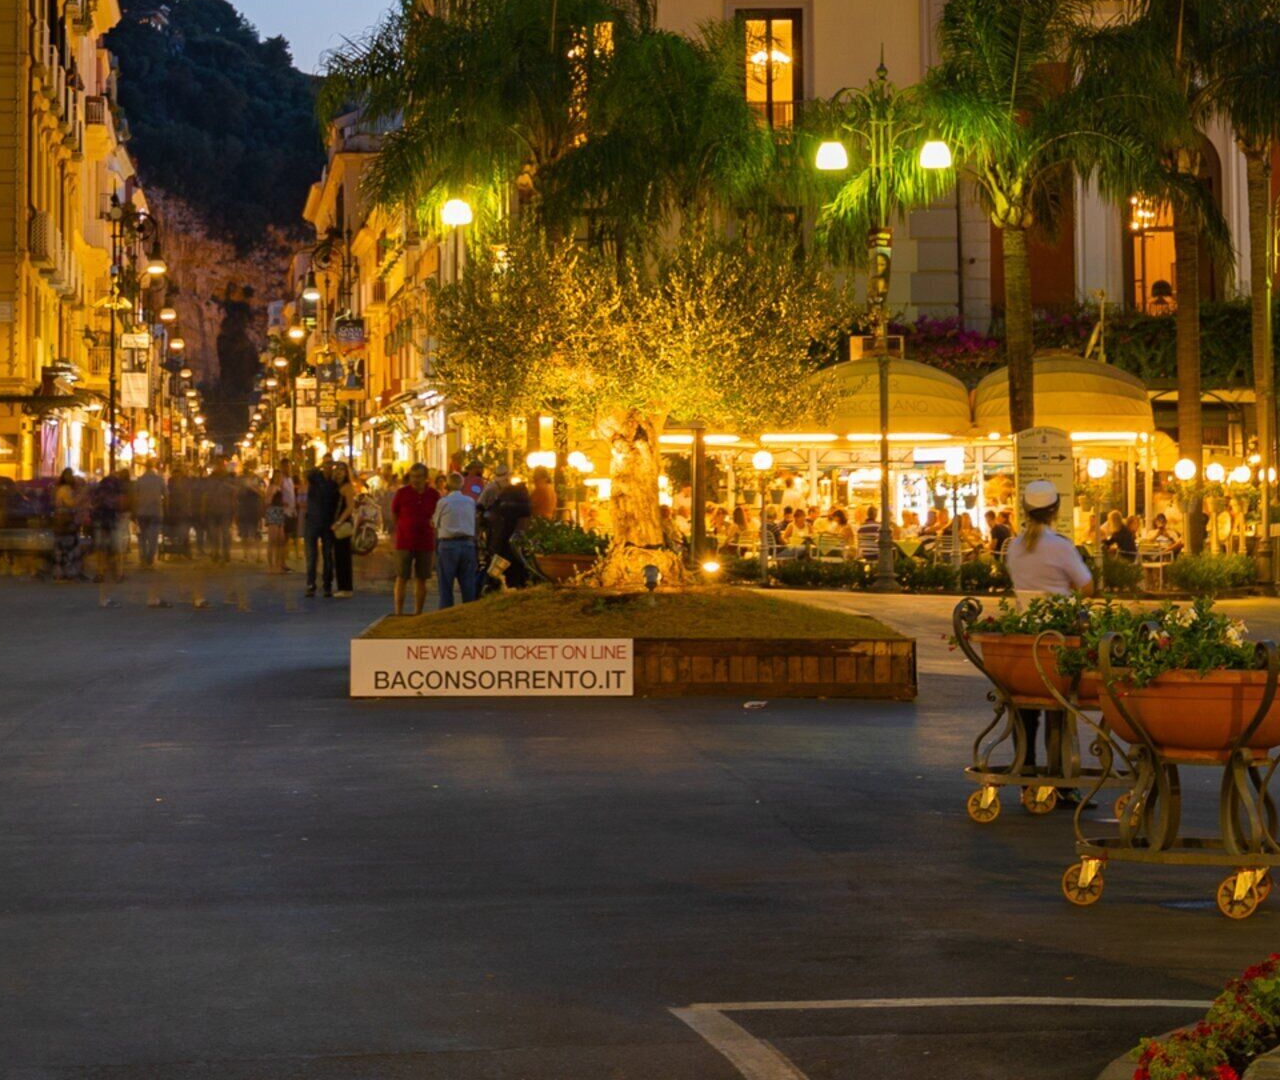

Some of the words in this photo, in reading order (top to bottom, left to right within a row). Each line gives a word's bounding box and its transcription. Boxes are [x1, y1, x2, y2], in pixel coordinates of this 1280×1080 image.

[406, 645, 458, 660] NEWS
[461, 645, 497, 660] AND
[500, 645, 558, 660] TICKET
[561, 645, 588, 660] ON
[591, 645, 627, 660] LINE
[374, 670, 626, 690] BACONSORRENTO.IT
